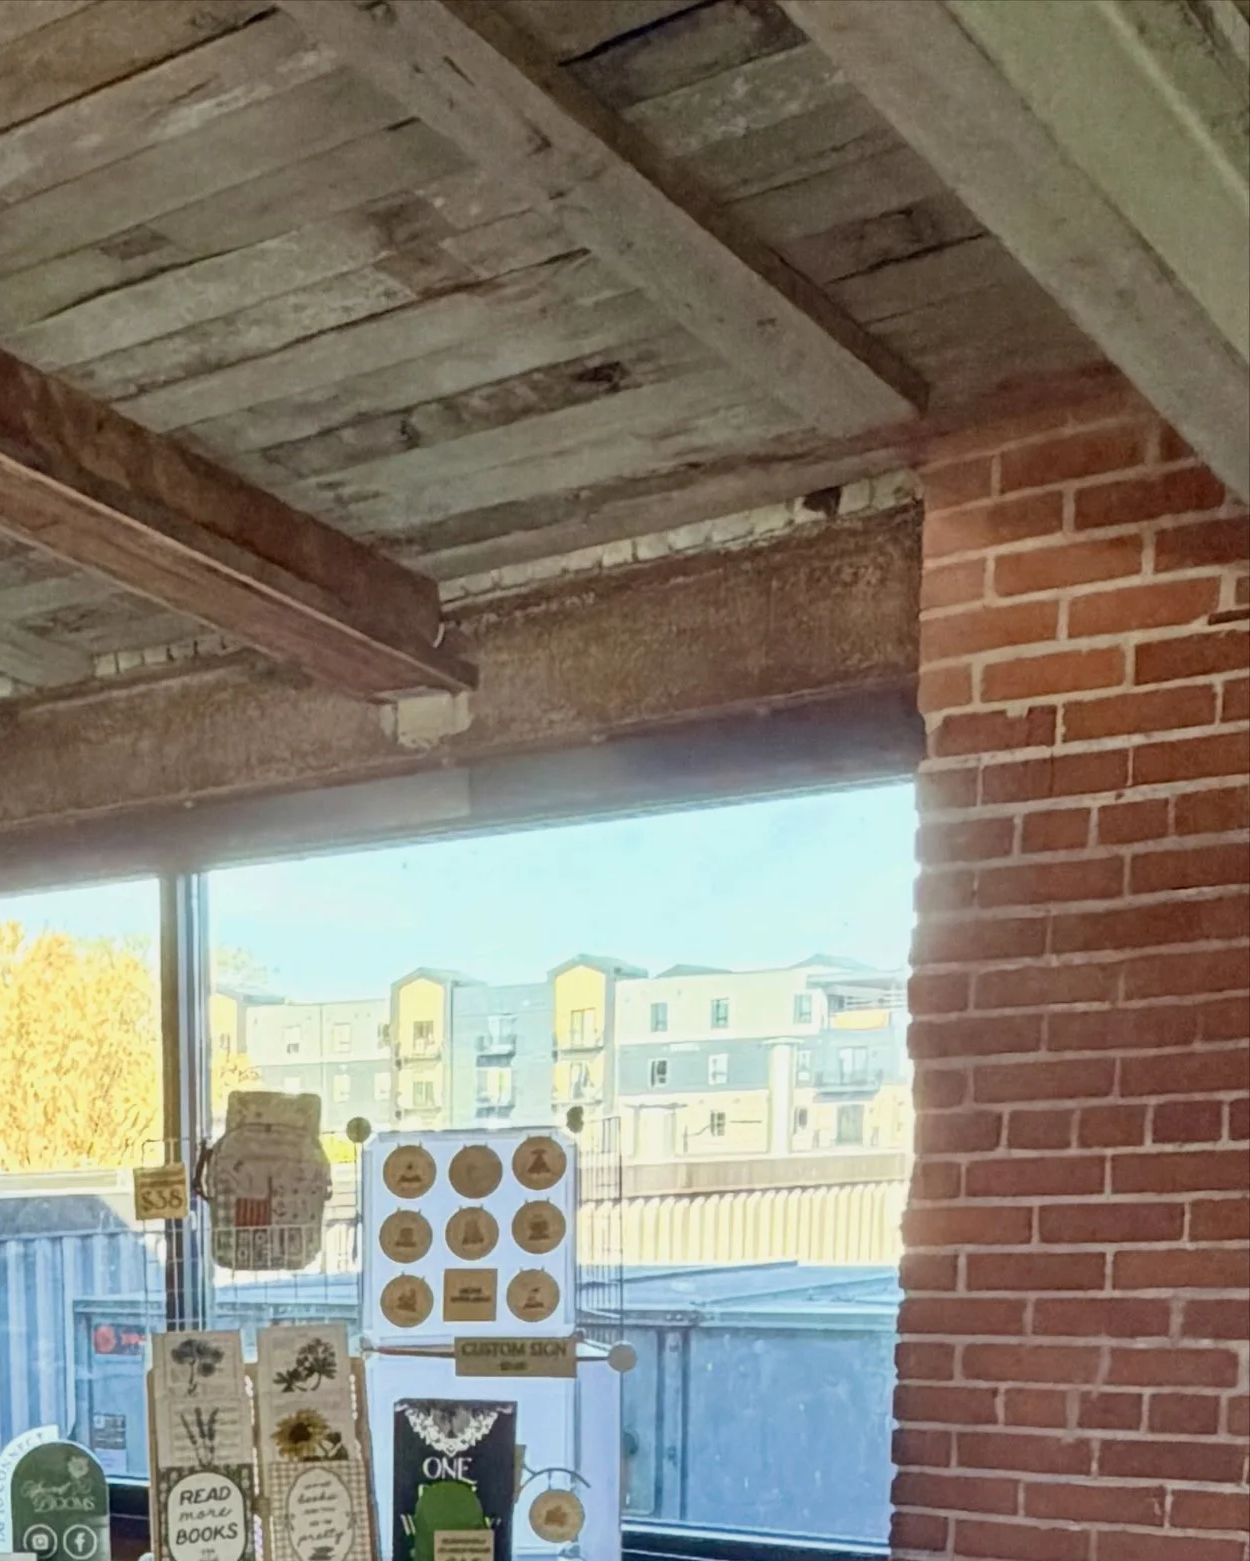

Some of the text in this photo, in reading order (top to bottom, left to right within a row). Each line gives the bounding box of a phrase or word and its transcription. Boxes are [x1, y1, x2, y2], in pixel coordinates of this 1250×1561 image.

[140, 1190, 183, 1213] $38
[461, 1341, 567, 1357] CUSTOM SIGN
[422, 1456, 478, 1485] ONE
[179, 1485, 232, 1506] READ
[178, 1506, 233, 1522] more
[175, 1521, 239, 1546] BOOKS
